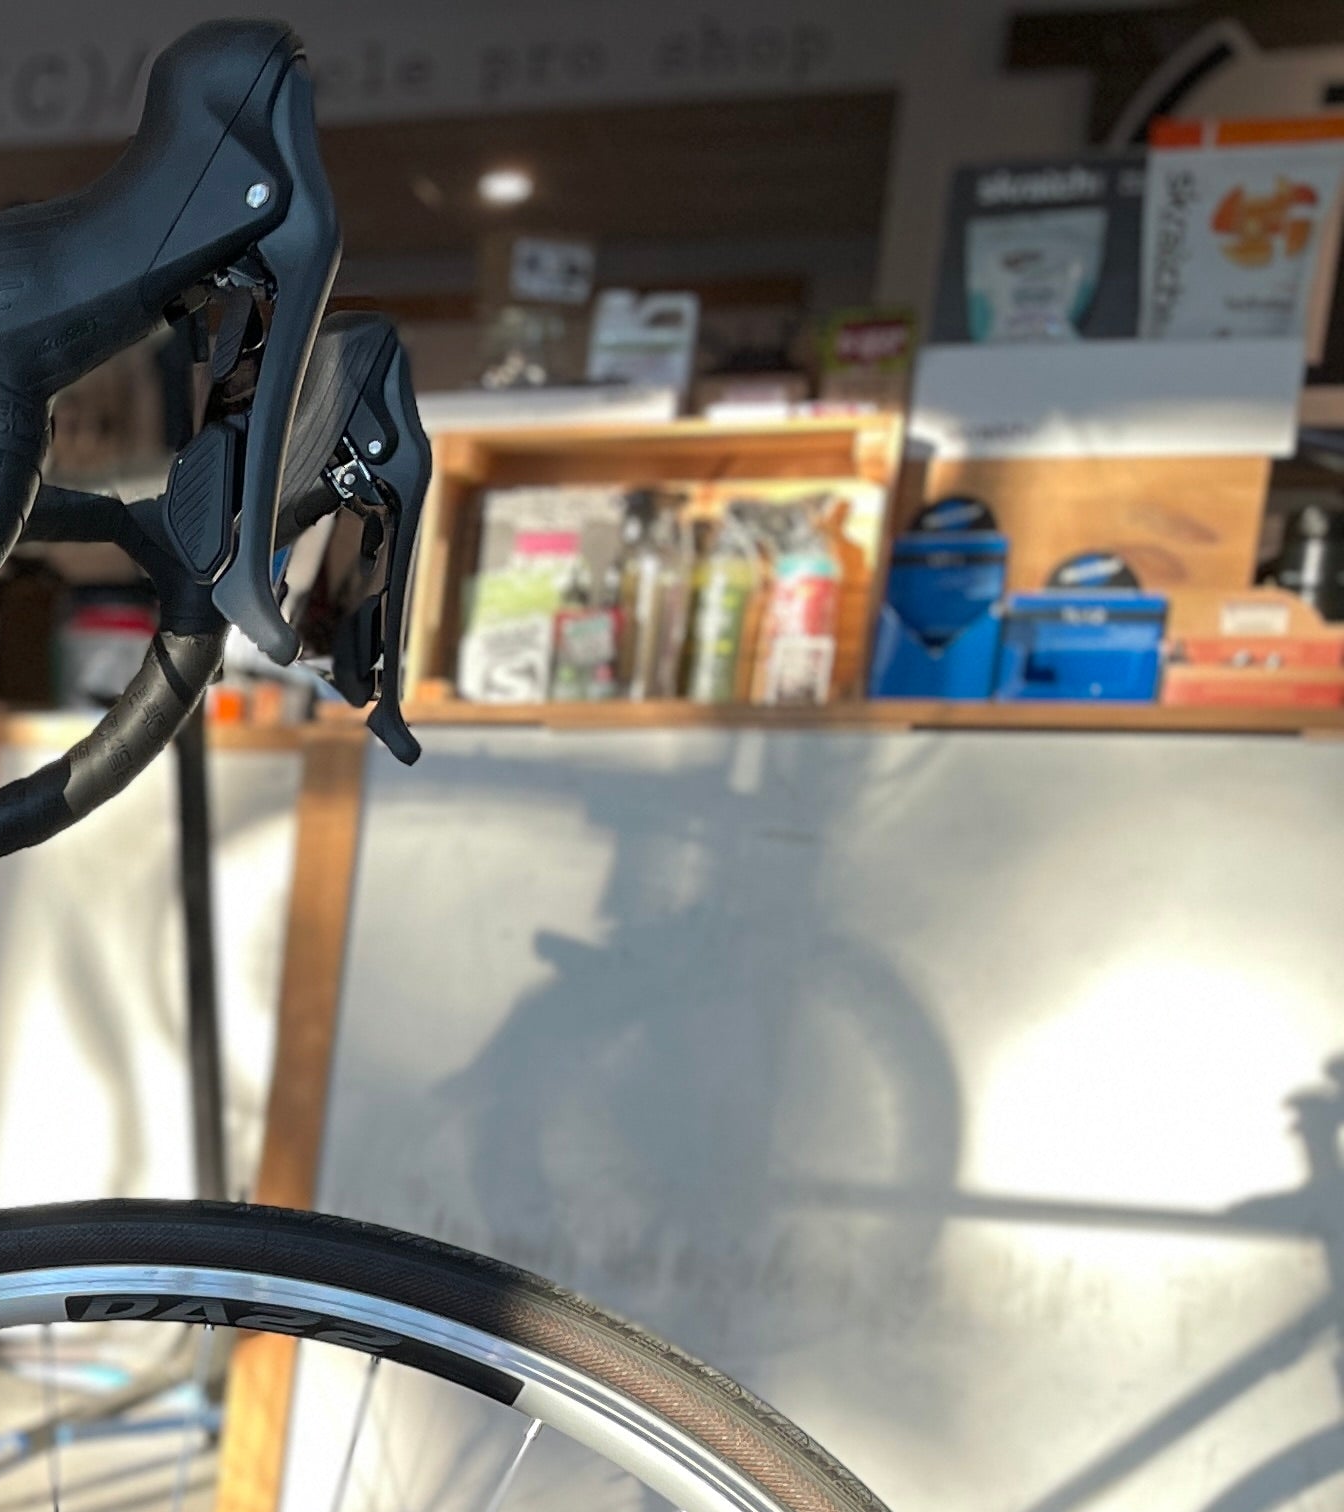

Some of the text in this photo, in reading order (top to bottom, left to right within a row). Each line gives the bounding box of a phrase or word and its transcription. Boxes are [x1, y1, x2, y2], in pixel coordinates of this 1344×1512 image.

[477, 40, 610, 96] pro
[655, 16, 834, 80] shop
[81, 1294, 403, 1354] DA22
